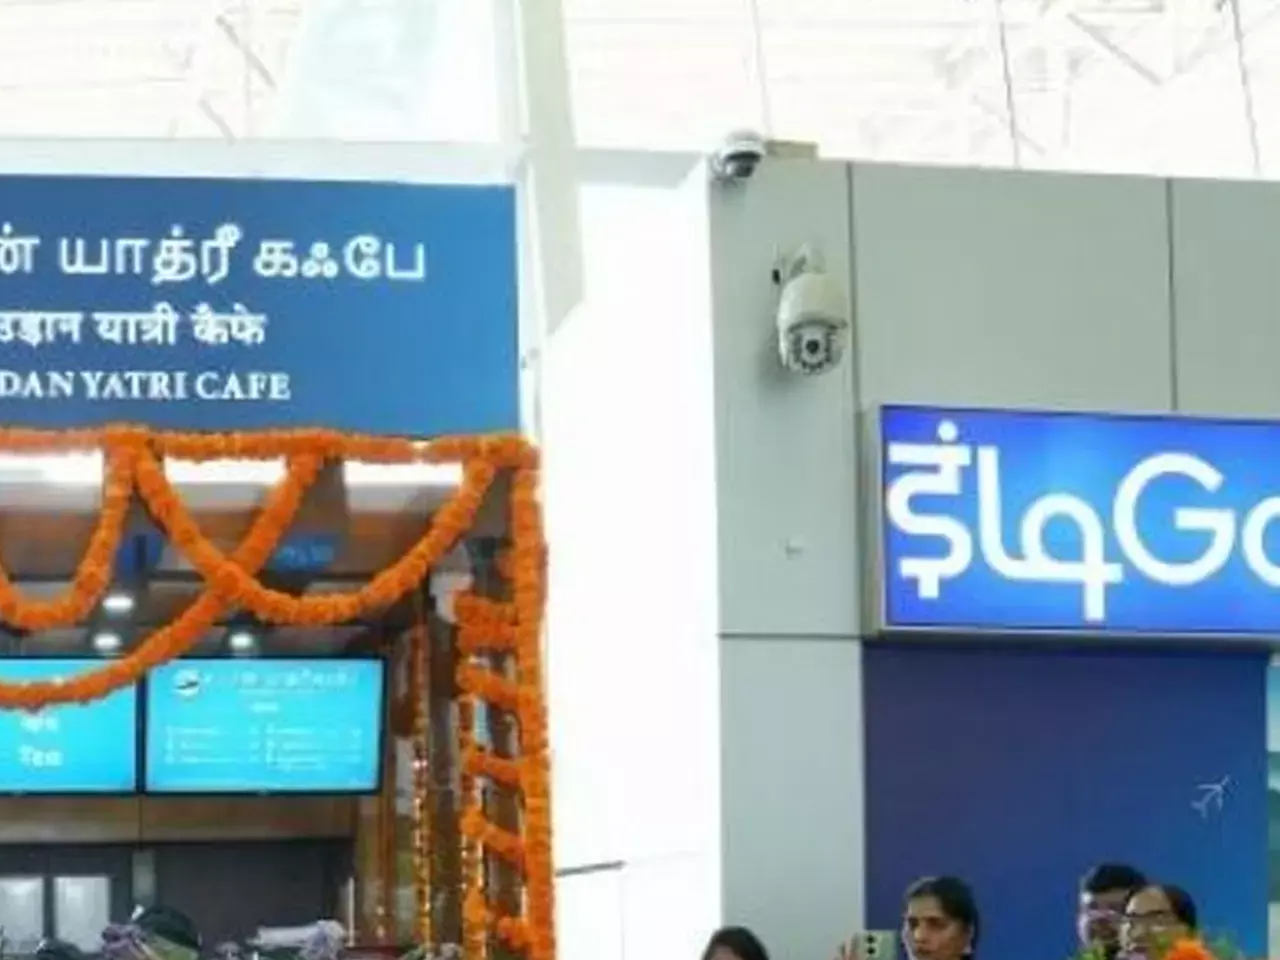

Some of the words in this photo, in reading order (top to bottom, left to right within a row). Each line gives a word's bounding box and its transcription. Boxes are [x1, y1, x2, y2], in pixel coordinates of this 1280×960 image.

[59, 223, 244, 286] யாத்ரீ
[252, 234, 426, 281] கஃபே
[92, 300, 180, 346] यात्री
[79, 370, 189, 400] YATRI
[195, 371, 291, 401] CAFE
